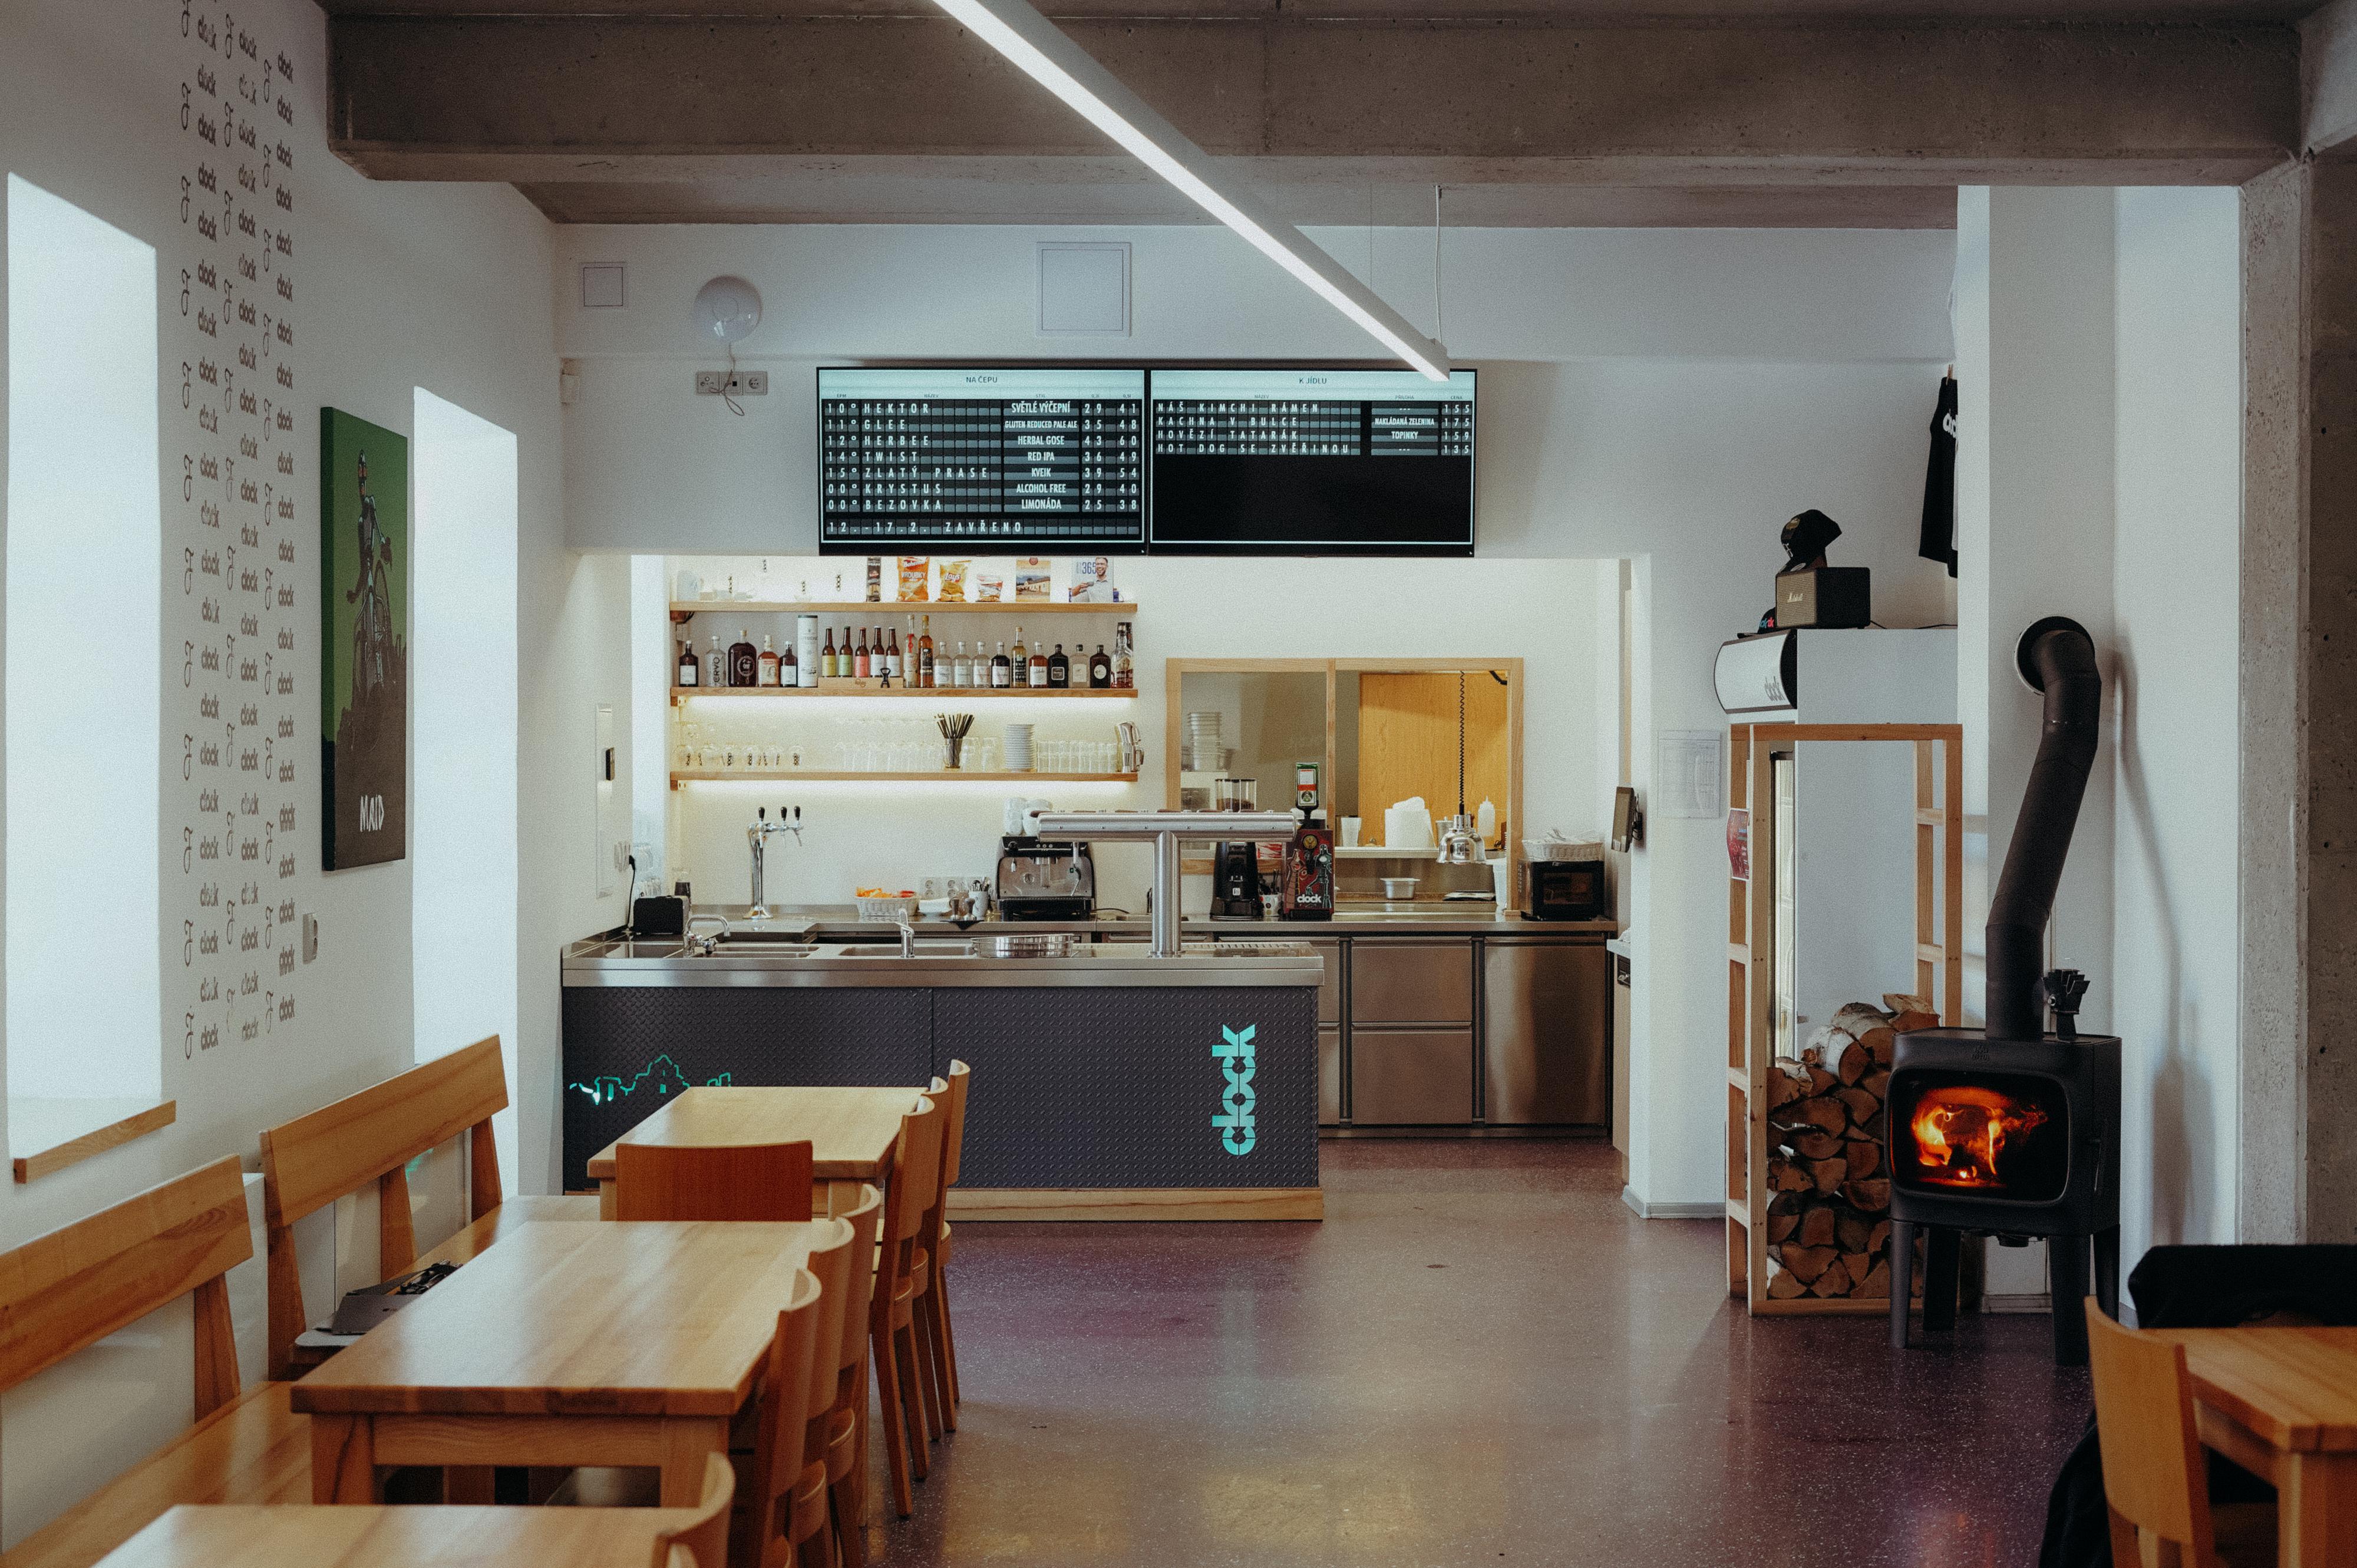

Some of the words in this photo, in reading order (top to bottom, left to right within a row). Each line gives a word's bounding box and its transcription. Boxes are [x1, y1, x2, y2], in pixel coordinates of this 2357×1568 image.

[864, 403, 928, 414] HEKTOR
[1012, 401, 1038, 413] SVĚTLÉ
[1039, 401, 1070, 413] VÝČEPNÍ
[1085, 404, 1101, 414] 29
[1120, 404, 1135, 414] 41
[1158, 401, 1184, 412] NÁŠ
[1199, 403, 1255, 412] KIMCHI
[1271, 402, 1318, 412] RÁMEN
[1445, 404, 1470, 413] 155
[864, 420, 904, 430] GLEE
[1085, 420, 1101, 430] 35
[1120, 420, 1137, 430] 48
[1158, 417, 1215, 425] KACHNA
[1230, 417, 1235, 425] V
[1250, 417, 1296, 426] BULCE
[1375, 417, 1408, 425] NAKLÁDANÁ
[1445, 418, 1469, 427] 175
[1158, 428, 1213, 439] HOVĚZÍ
[1230, 429, 1297, 440] TATARÁK
[1391, 431, 1418, 440] TOPINKY
[1445, 431, 1469, 440] 159
[864, 435, 928, 445] HERBEE
[1018, 435, 1044, 445] HERBAL
[1046, 435, 1065, 445] GOSE
[1084, 435, 1102, 445] 43
[1120, 435, 1137, 445] 60
[1158, 444, 1183, 453] HOT
[1199, 444, 1224, 453] DOG
[1240, 444, 1255, 453] SE
[1271, 443, 1348, 454] ZVĚŘINOU
[1444, 445, 1469, 454] 135
[865, 451, 917, 462] TWIST
[1028, 452, 1042, 461] RED
[1044, 452, 1055, 461] IPA
[1085, 451, 1101, 462] 36
[1120, 451, 1136, 461] 49
[865, 466, 917, 478] ZLATÝ
[935, 467, 986, 478] PRASE
[1031, 468, 1051, 477] KVEIK
[1085, 467, 1101, 478] 39
[1120, 468, 1137, 478] 54
[866, 484, 940, 494] KRYSTUS
[1016, 484, 1048, 493] ALCOHOL
[1049, 484, 1066, 493] FREE
[1085, 484, 1101, 494] 29
[1120, 484, 1137, 494] 40
[866, 500, 941, 510] BEZOVKA
[1021, 497, 1062, 509] LIMONÁDA
[1085, 500, 1102, 510] 25
[1120, 500, 1136, 510] 38
[946, 520, 1021, 532] ZAVŘENO
[1296, 894, 1322, 903] clock
[1211, 1024, 1256, 1156] clock
